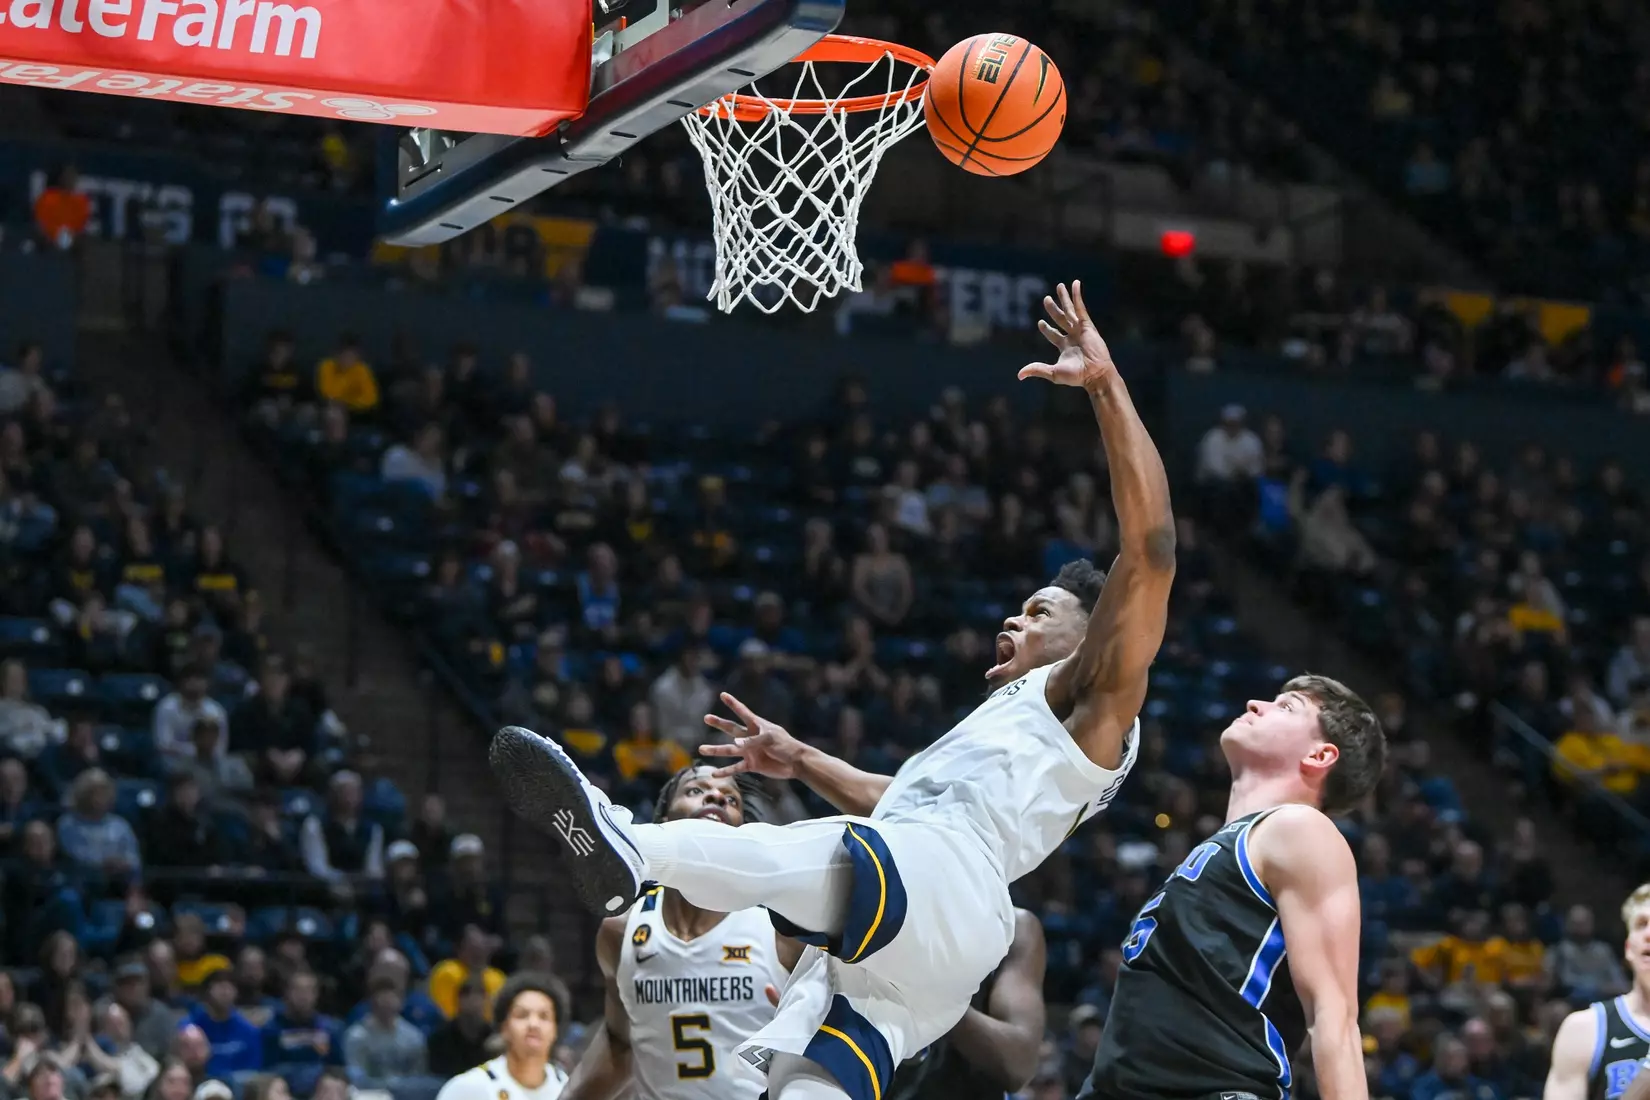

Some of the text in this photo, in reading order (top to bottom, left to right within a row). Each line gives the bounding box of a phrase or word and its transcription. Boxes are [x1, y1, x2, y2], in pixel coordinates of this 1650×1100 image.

[976, 35, 1018, 84] ELITE
[634, 976, 754, 1005] MOUNTAINEERS
[670, 1013, 716, 1081] 5
